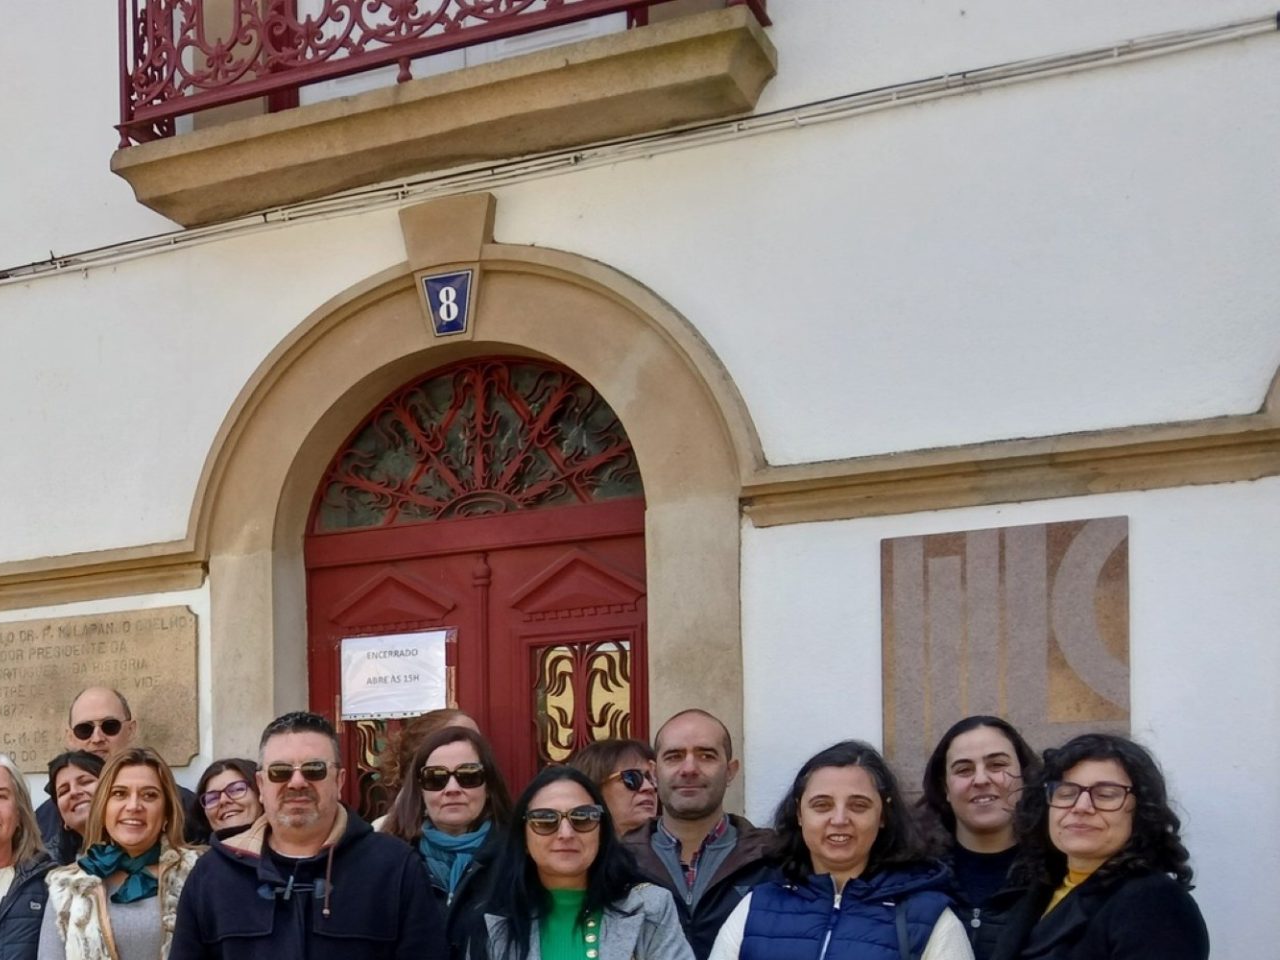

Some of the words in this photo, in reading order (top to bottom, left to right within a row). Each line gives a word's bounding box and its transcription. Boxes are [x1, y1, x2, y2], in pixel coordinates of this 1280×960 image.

[438, 286, 459, 322] 8
[28, 641, 107, 660] PRESIDENTE
[366, 648, 419, 660] ENCERRADO
[366, 676, 388, 685] ABRE
[404, 674, 420, 683] 15H
